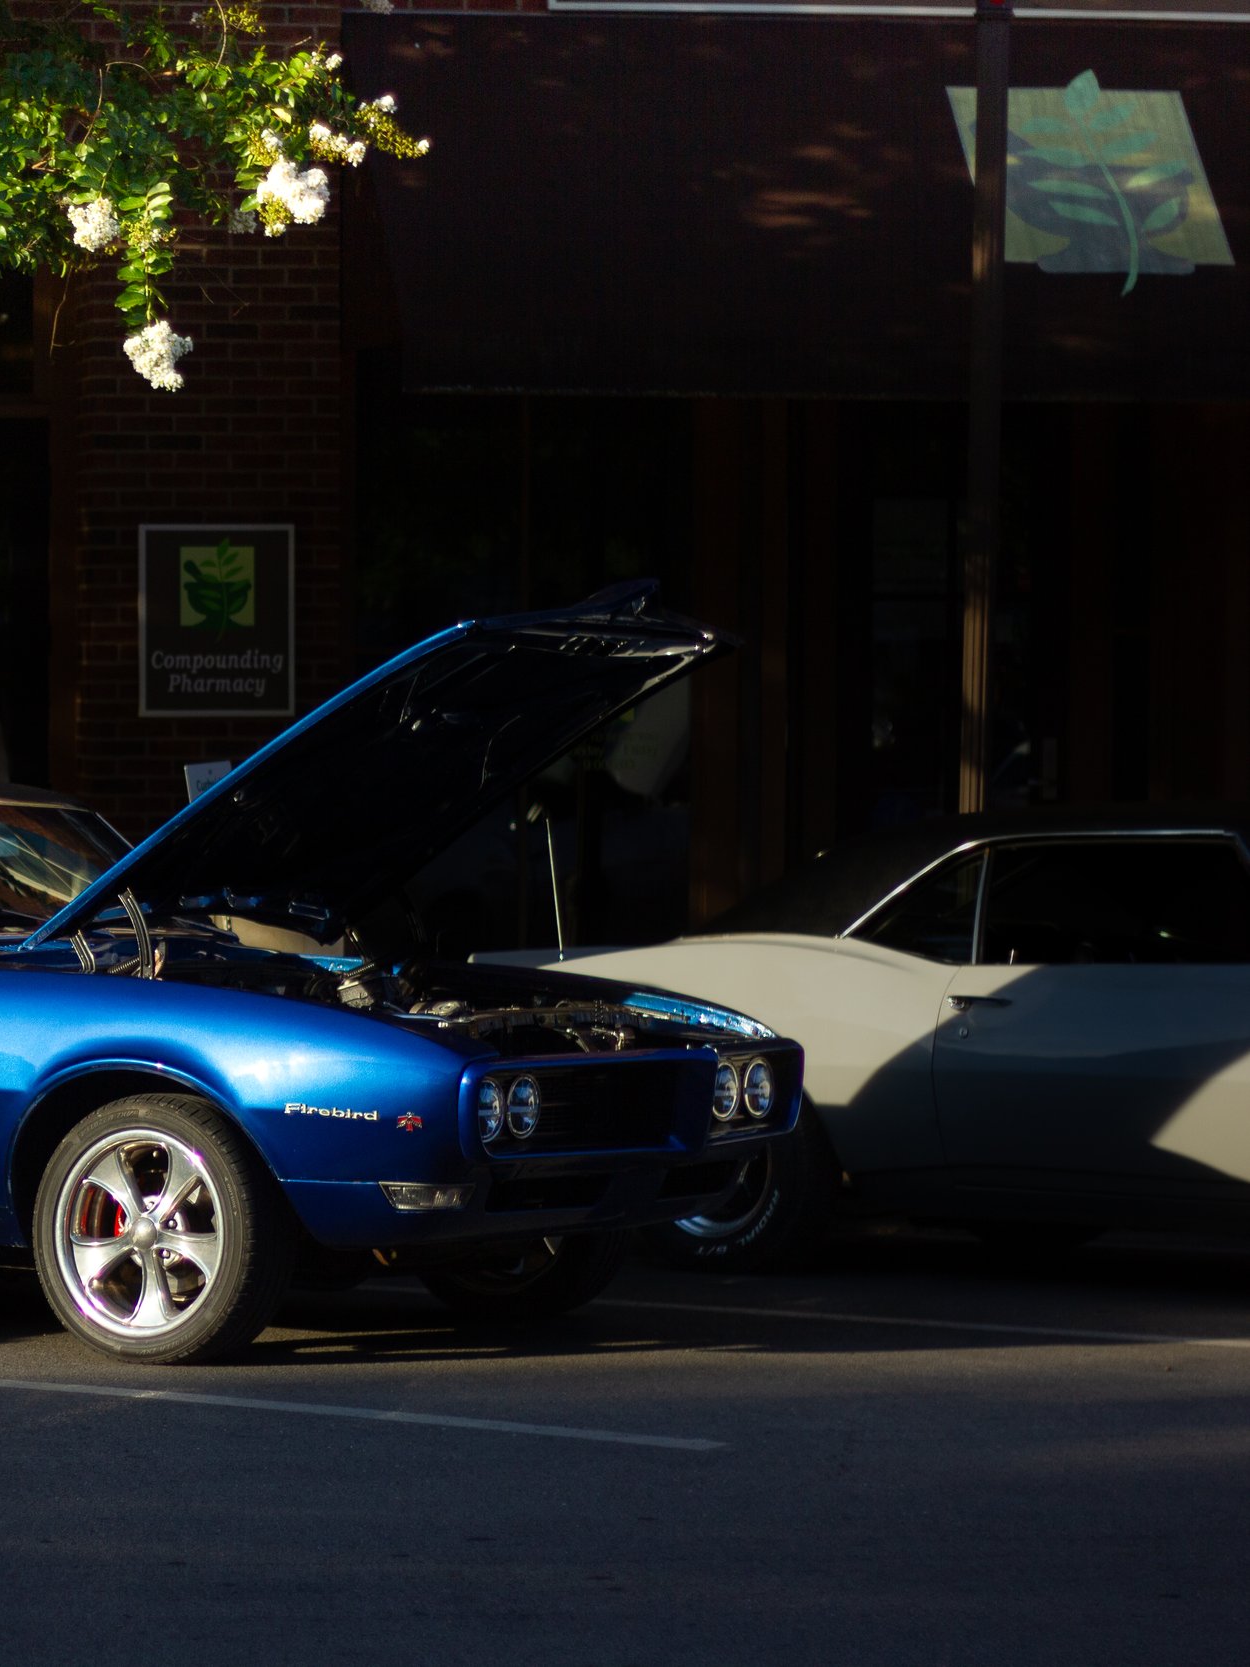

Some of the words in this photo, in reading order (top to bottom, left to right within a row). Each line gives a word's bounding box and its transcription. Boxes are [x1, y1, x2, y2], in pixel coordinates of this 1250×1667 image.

[150, 648, 284, 675] Compounding
[167, 673, 267, 699] Pharmacy
[283, 1103, 379, 1121] Firebird
[736, 1185, 780, 1247] RADIAL
